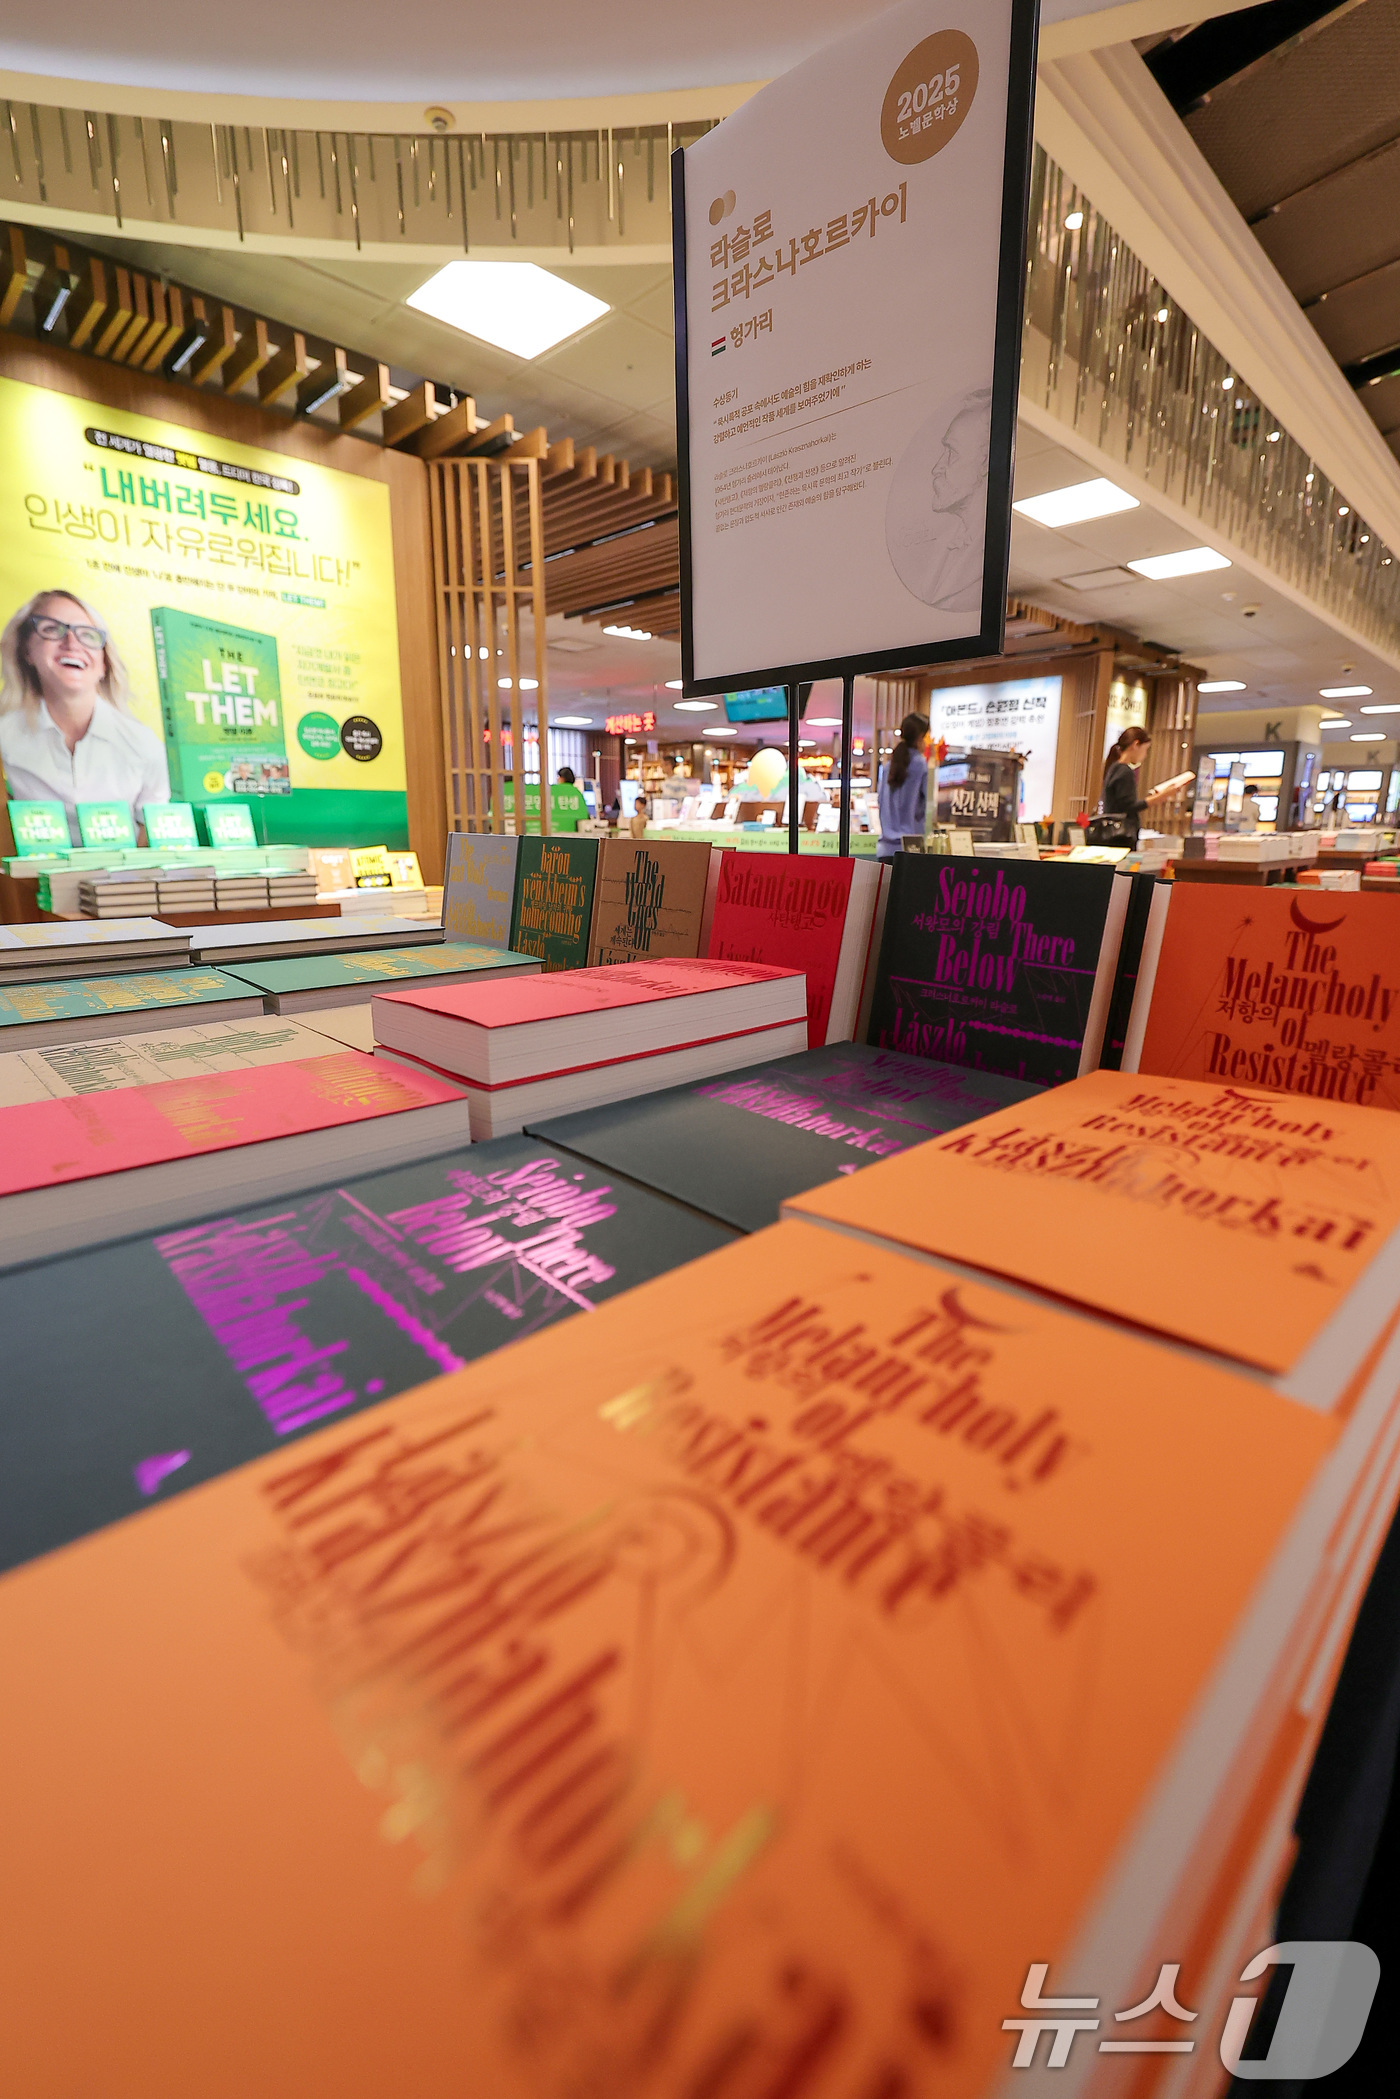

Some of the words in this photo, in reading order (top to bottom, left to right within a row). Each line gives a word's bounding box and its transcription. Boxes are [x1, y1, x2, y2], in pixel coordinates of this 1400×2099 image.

[897, 64, 960, 123] 2025
[898, 97, 959, 141] 노벨문학상
[710, 209, 774, 270] 라슬로
[711, 181, 907, 312] 크라스나호르카이
[730, 308, 773, 349] 헝가리
[713, 387, 739, 409] 수상동기
[741, 404, 753, 418] 공포
[754, 393, 780, 412] 속에서도
[781, 383, 802, 400] 예술의
[803, 378, 817, 393] 힘을
[818, 363, 855, 386] 재확인하게
[856, 358, 873, 371] 하는
[713, 427, 737, 445] 강렬하고
[737, 416, 762, 434] 예언적인
[762, 410, 775, 424] 작품
[776, 402, 797, 418] 세계를
[23, 493, 131, 547] 인생이
[139, 517, 362, 588] 자유로워집니다!”
[202, 658, 260, 695] LET
[218, 647, 244, 663] THE
[185, 691, 279, 727] THEM
[1264, 721, 1282, 741] K
[1367, 750, 1381, 764] K
[951, 789, 975, 816] 신간
[540, 843, 571, 877] baron
[633, 850, 659, 884] The
[625, 871, 665, 909] World
[719, 859, 846, 929] Satantango
[934, 866, 1027, 925] Seiobo
[520, 898, 583, 945] homecoming
[769, 910, 814, 931] 사탄탱고
[911, 913, 965, 936] 서왕모의
[970, 919, 1001, 940] 강림
[1011, 919, 1076, 966] There
[934, 933, 1024, 993] Below
[1284, 930, 1338, 975] The
[1215, 998, 1282, 1028] 저항의
[1219, 956, 1400, 1032] Melancholy
[1280, 1009, 1309, 1051] of
[1205, 1032, 1378, 1107] Resistance
[486, 1157, 618, 1229] Seiobo
[384, 1191, 522, 1274] Below
[512, 1222, 617, 1291] There
